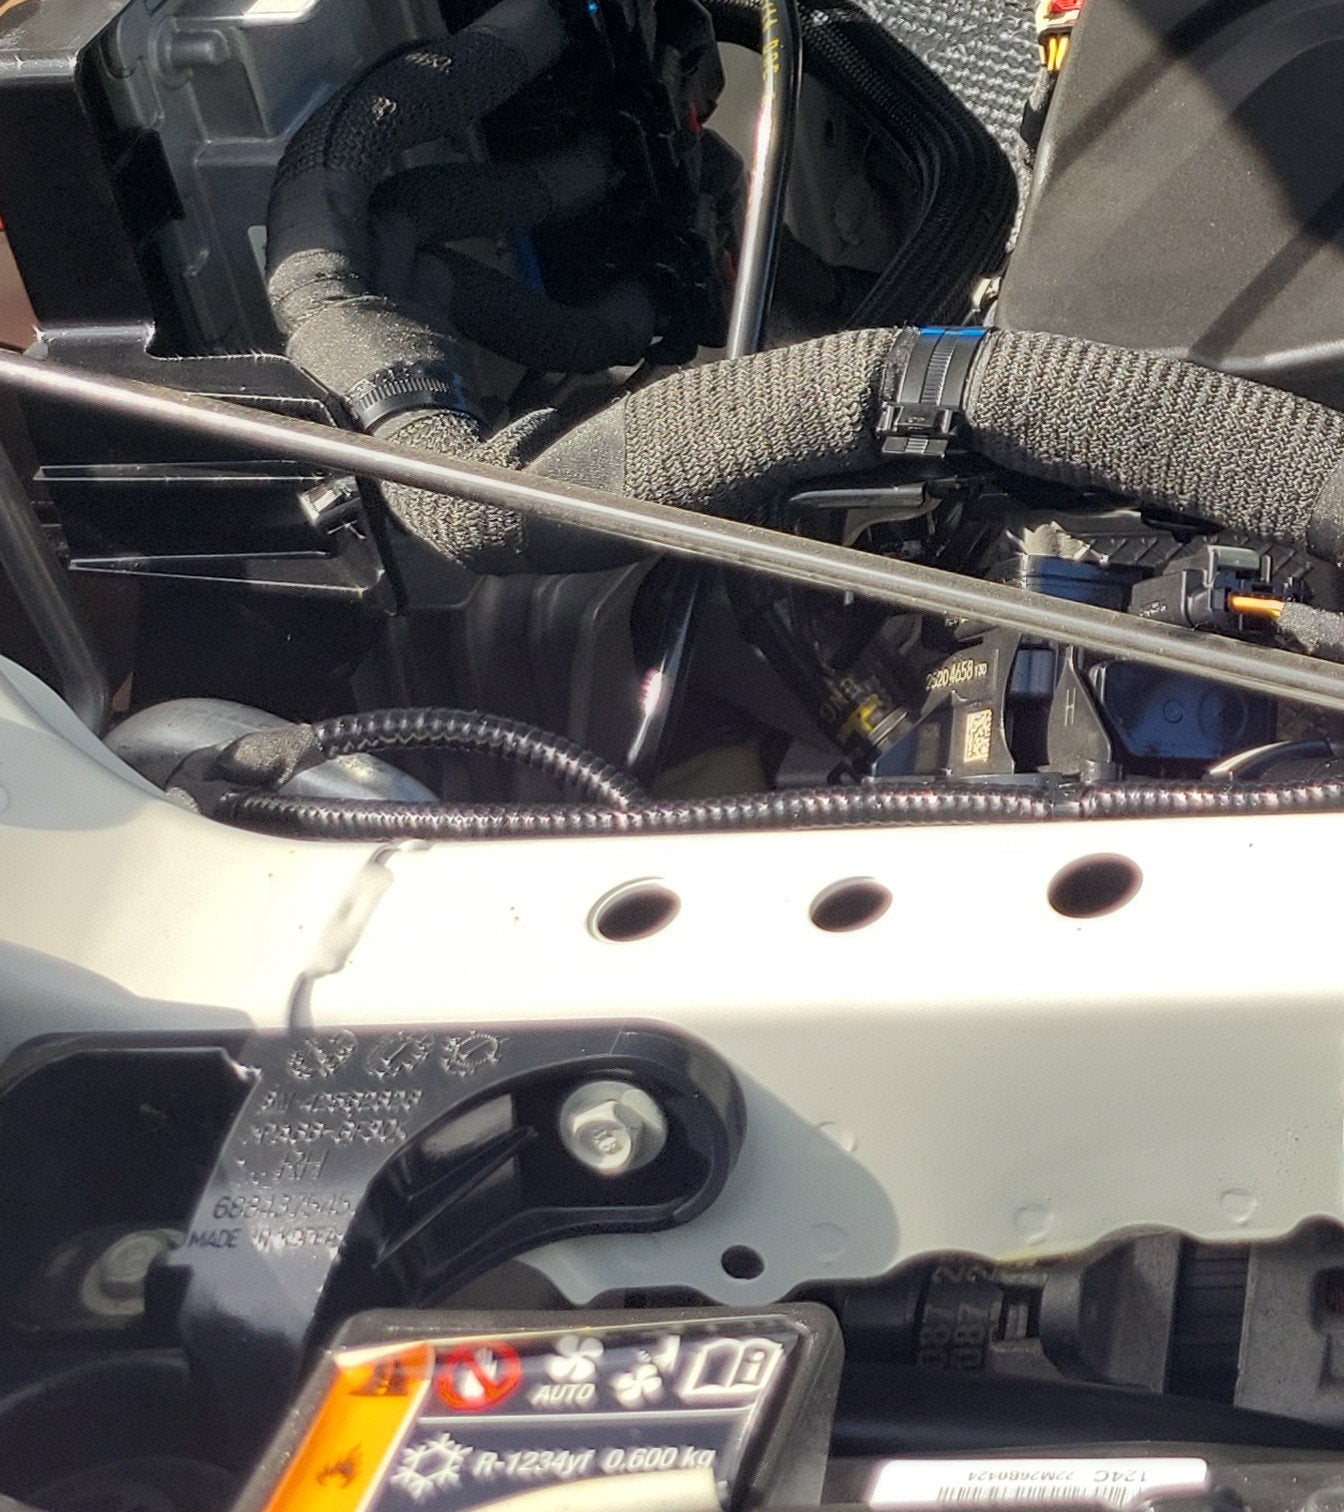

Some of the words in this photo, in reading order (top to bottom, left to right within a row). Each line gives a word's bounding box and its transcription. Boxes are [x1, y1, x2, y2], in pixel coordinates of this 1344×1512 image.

[275, 1148, 330, 1181] RH
[187, 1227, 239, 1250] MADE
[531, 1383, 596, 1407] AUTO
[471, 1448, 594, 1478] R-1234yf
[602, 1447, 673, 1471] 0.600
[674, 1448, 718, 1475] kg
[1093, 1468, 1149, 1484] 124C
